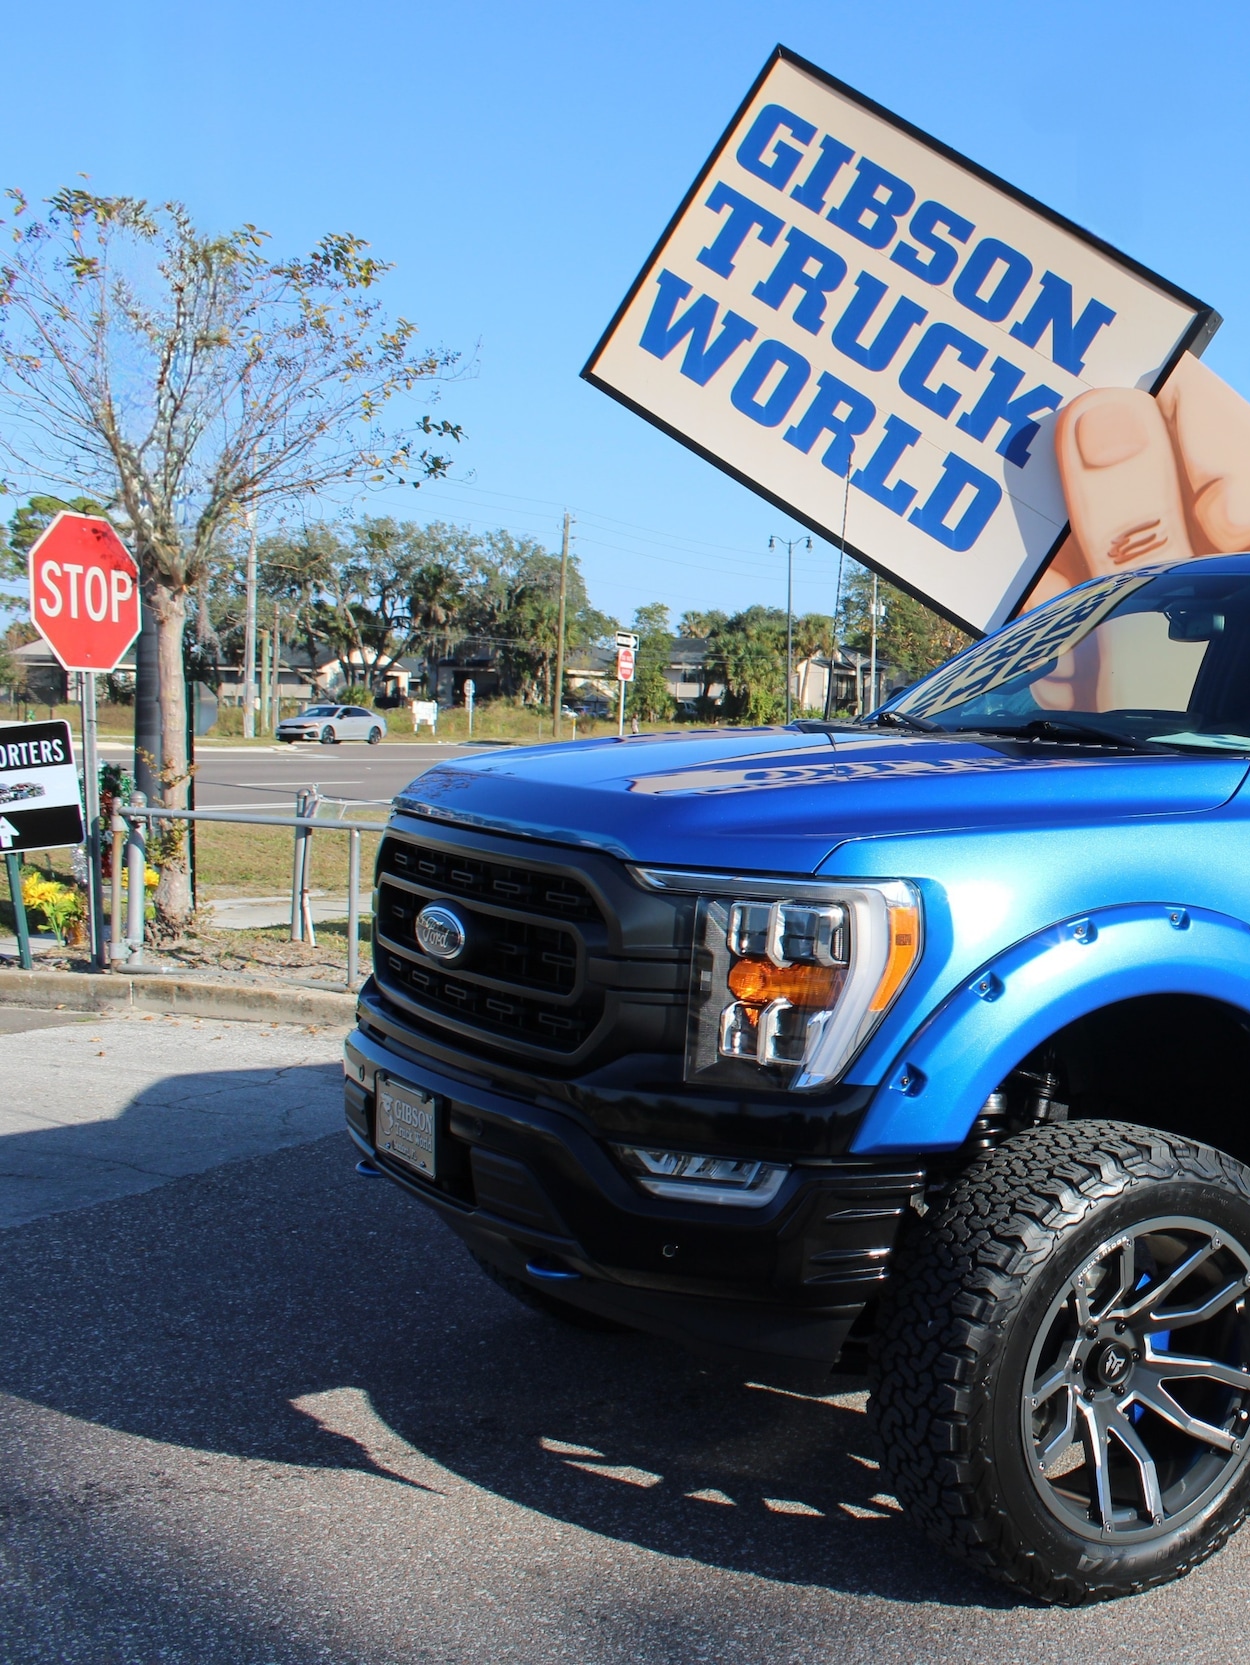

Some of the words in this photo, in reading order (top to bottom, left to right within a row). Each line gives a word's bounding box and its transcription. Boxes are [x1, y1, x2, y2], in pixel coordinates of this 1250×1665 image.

[736, 104, 1116, 375] GIBSON
[696, 181, 1064, 468] TRUCK
[639, 269, 1002, 551] WORLD
[40, 560, 133, 623] STOP
[422, 916, 449, 948] Ford
[394, 1100, 433, 1135] GIBSON
[394, 1122, 414, 1143] Truck
[415, 1131, 433, 1153] World
